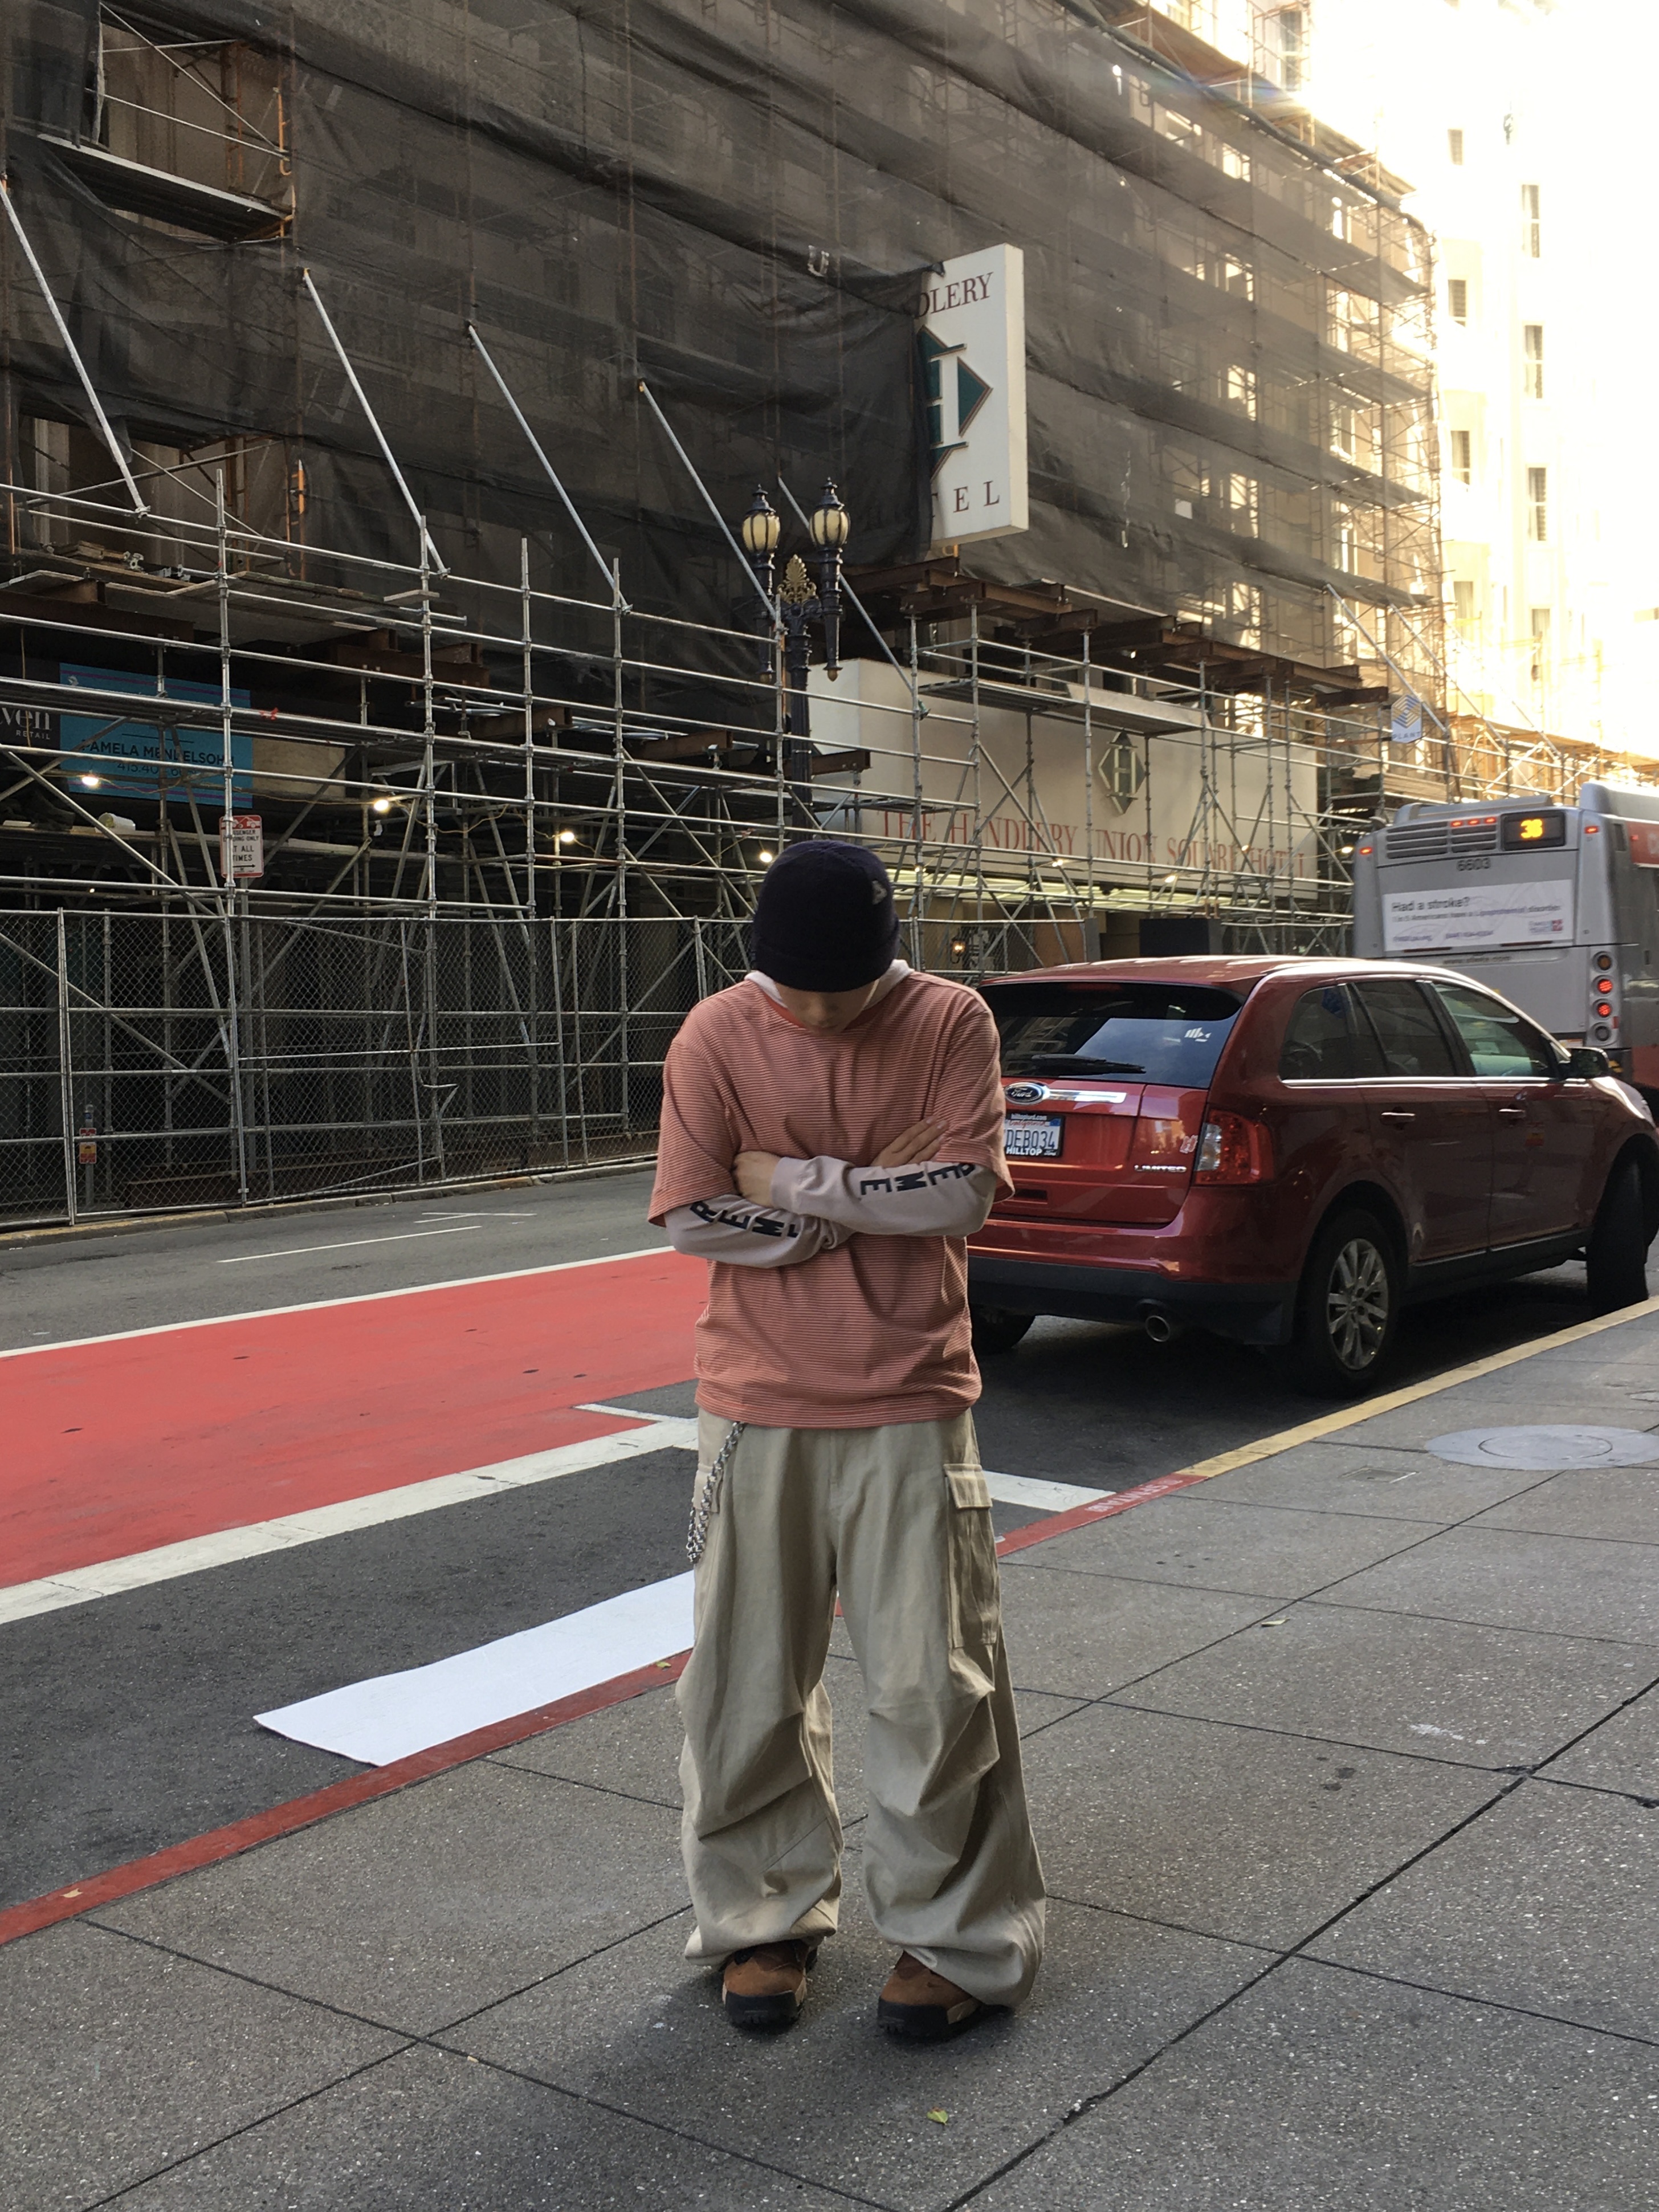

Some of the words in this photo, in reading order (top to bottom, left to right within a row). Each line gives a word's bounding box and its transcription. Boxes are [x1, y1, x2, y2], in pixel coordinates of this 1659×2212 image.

[0, 707, 52, 731] ven
[16, 730, 50, 740] RETAIL
[144, 746, 234, 766] MENELSOH
[951, 812, 1078, 856] HNDLERY
[1392, 901, 1415, 912] Had
[1428, 897, 1470, 910] stroke?
[1011, 1087, 1032, 1098] Ford
[1006, 1129, 1055, 1148] DEB034
[1006, 1147, 1042, 1156] HILLTOP
